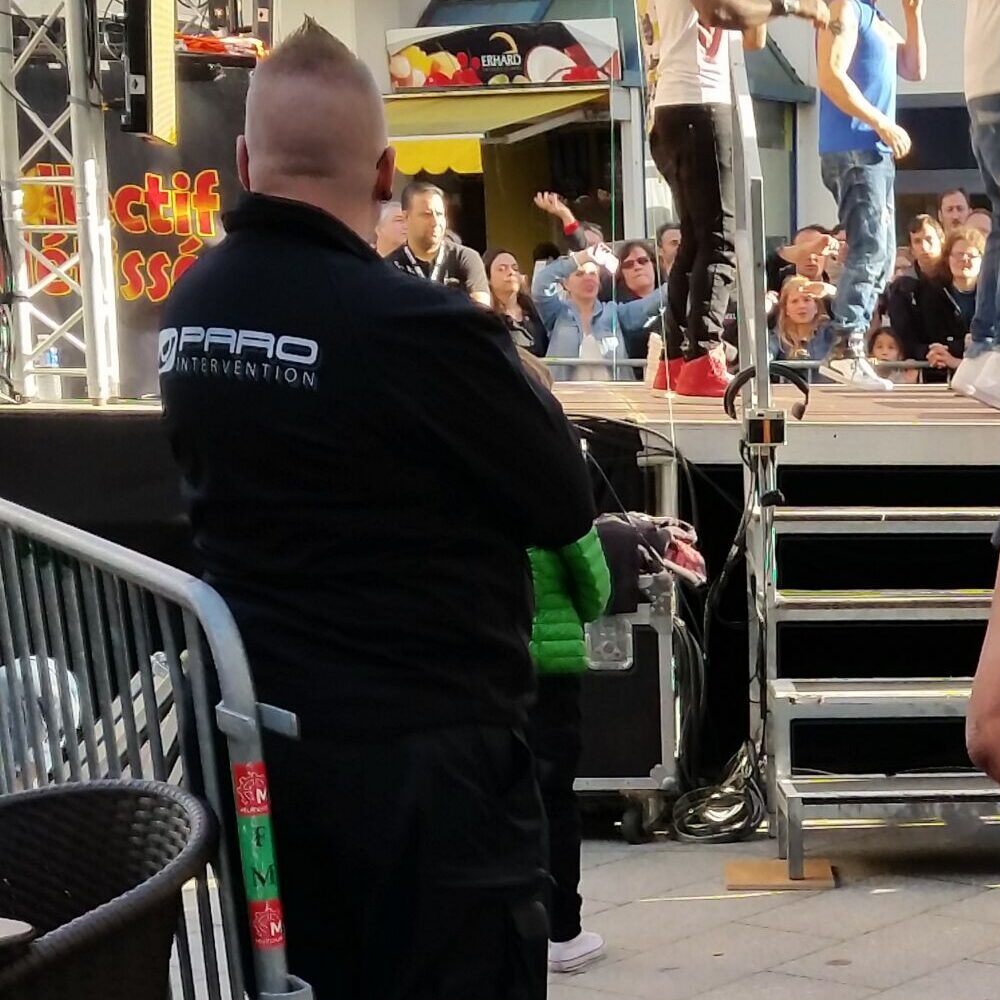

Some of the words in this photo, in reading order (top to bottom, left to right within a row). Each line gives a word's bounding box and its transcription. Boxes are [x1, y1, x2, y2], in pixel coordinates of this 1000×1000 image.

[481, 54, 521, 67] ERHARD
[178, 326, 319, 365] PARO
[175, 356, 315, 387] INTERVENTION
